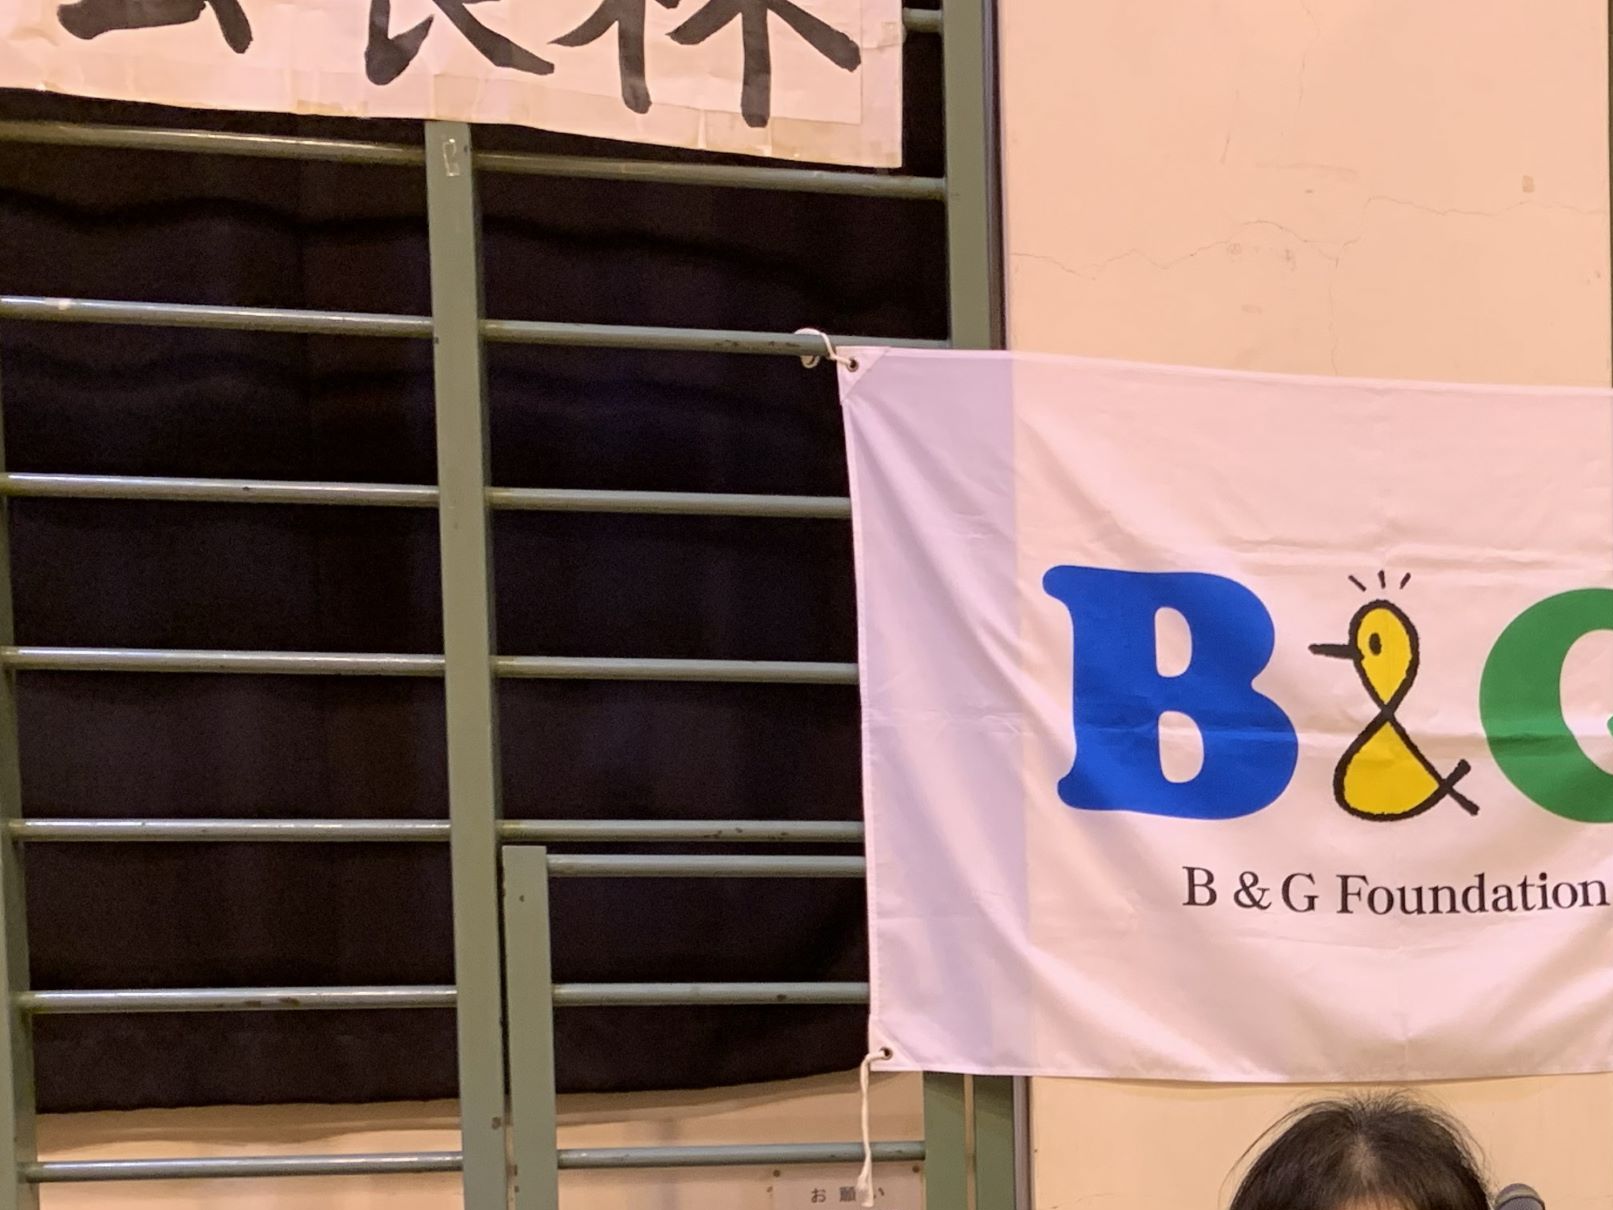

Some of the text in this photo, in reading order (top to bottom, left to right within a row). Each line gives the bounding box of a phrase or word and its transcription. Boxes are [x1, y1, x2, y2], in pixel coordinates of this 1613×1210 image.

[1181, 865, 1218, 907] B
[1232, 871, 1272, 910] &
[1335, 871, 1611, 916] Foundation
